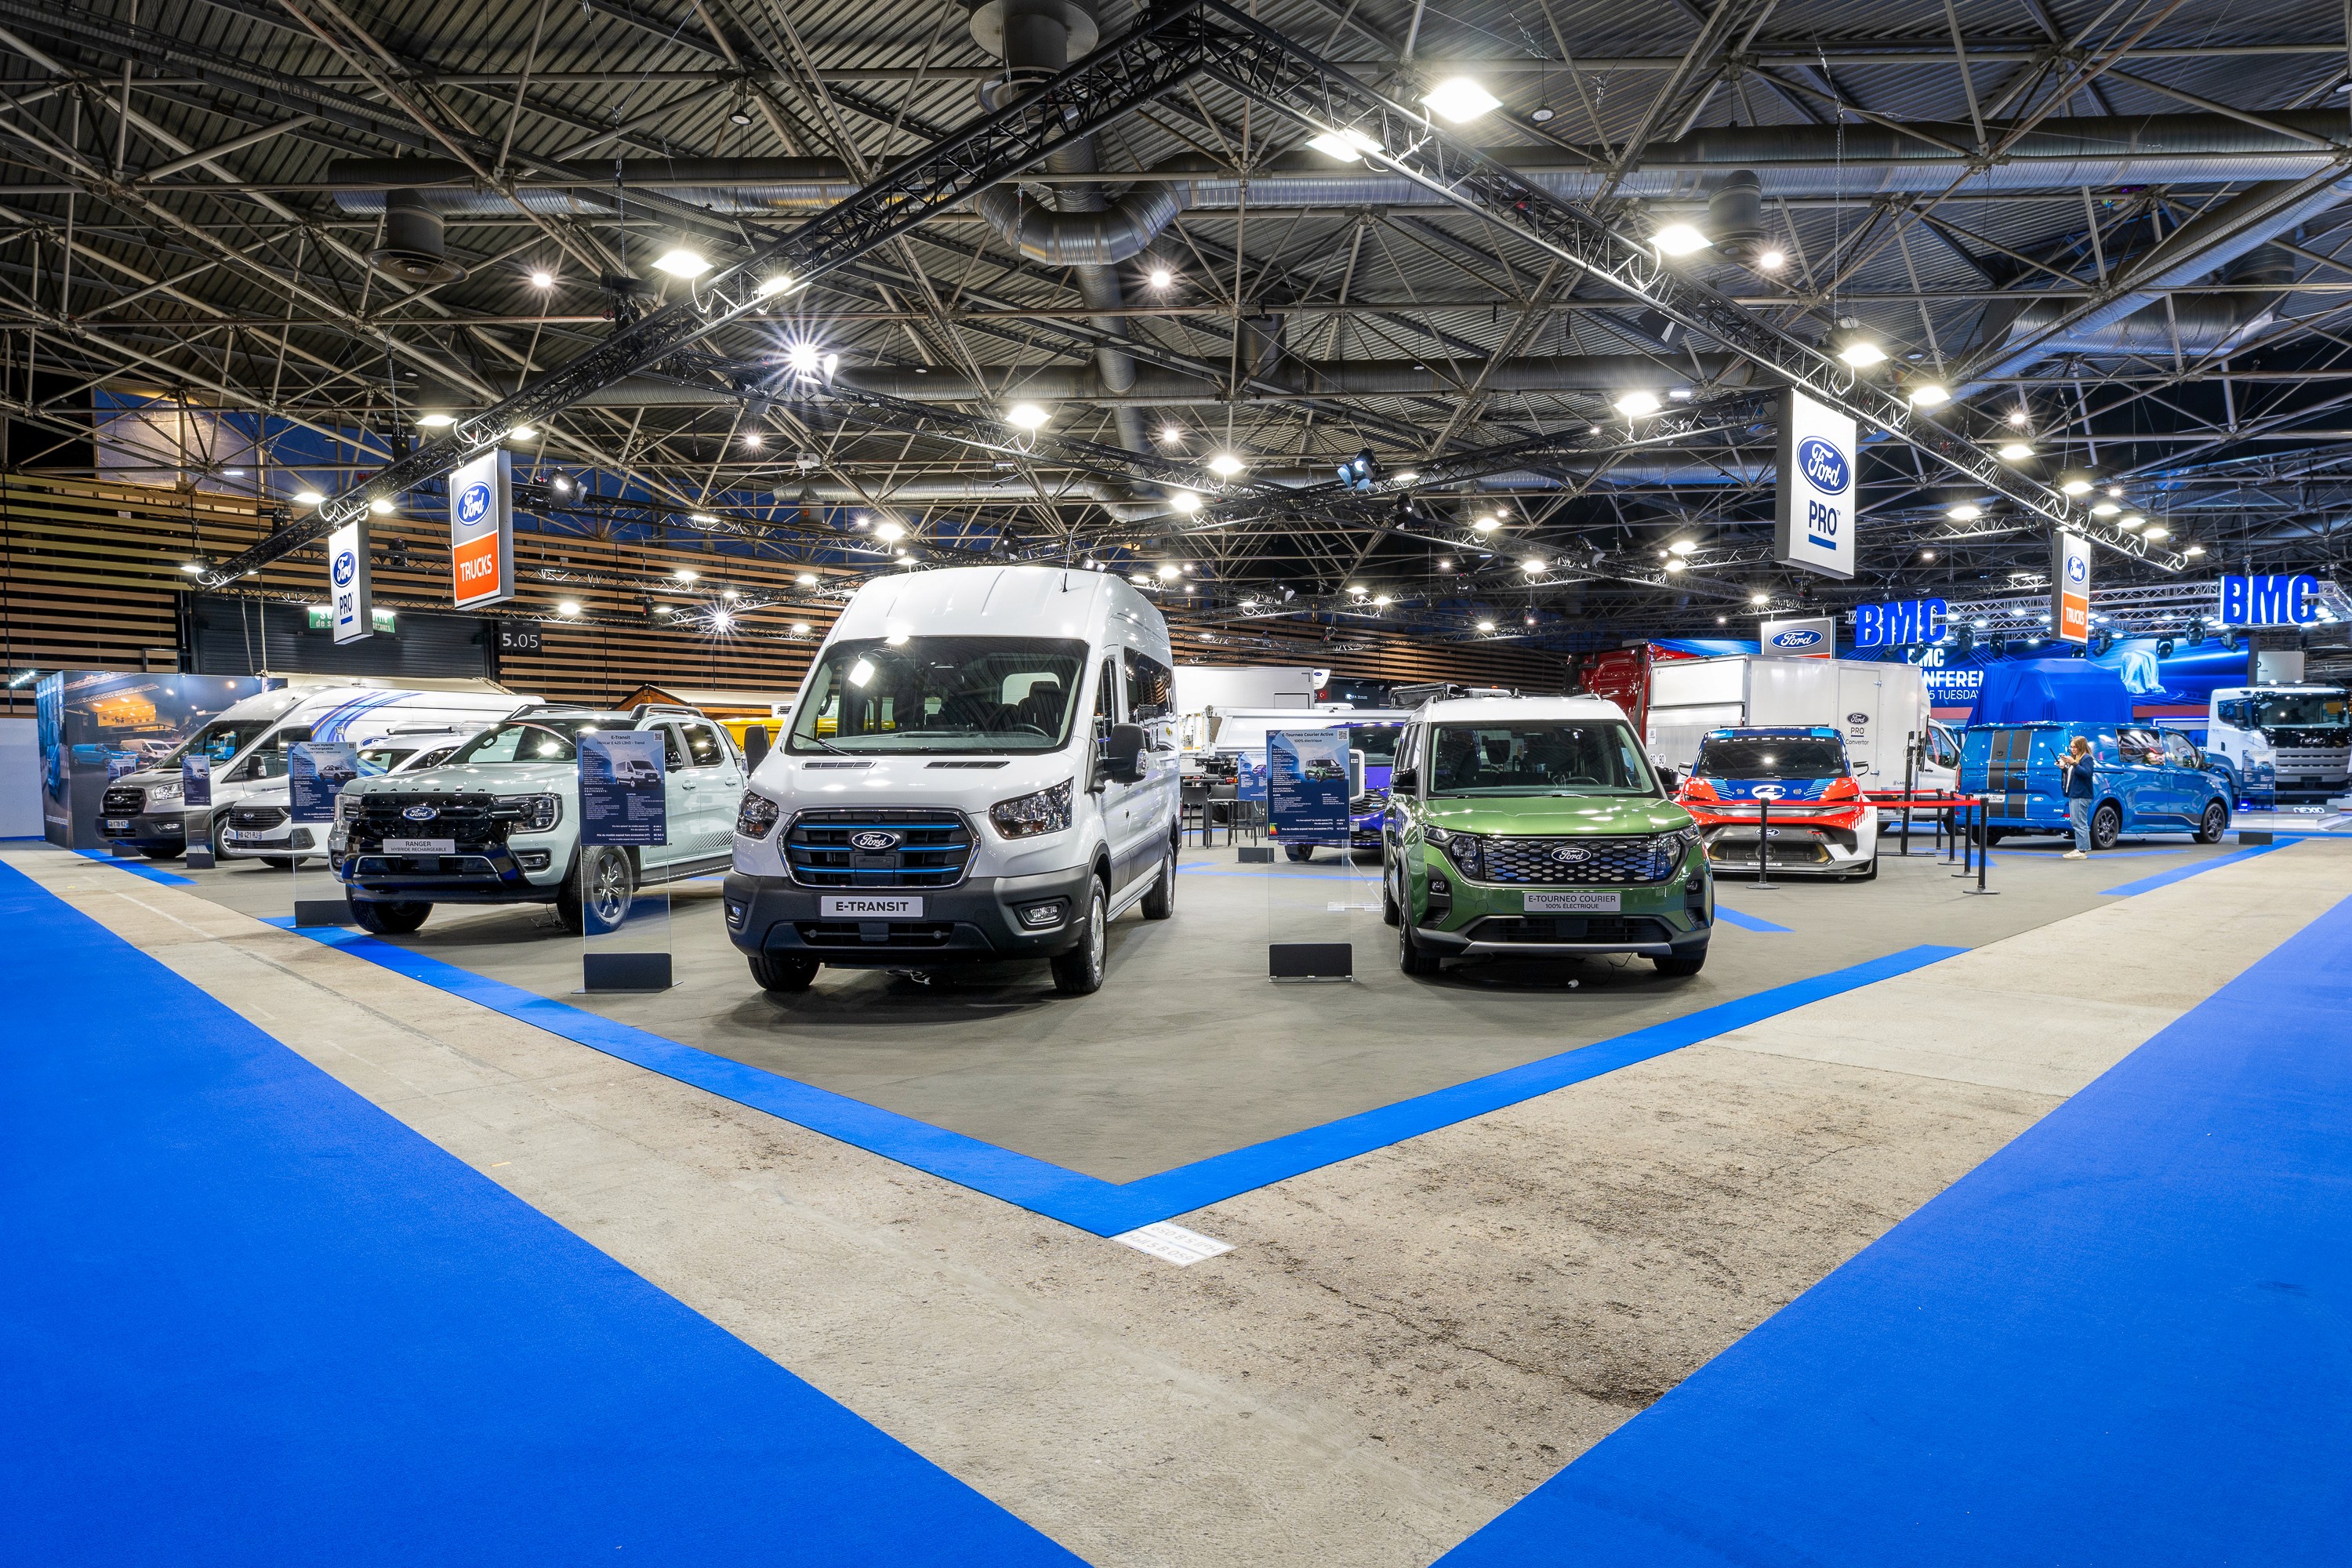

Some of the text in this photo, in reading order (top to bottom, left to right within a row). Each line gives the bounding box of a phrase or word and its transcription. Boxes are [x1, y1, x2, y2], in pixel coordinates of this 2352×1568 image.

[1808, 443, 1841, 488] Ford
[463, 488, 484, 518] Ford
[337, 557, 352, 581] Ford
[459, 554, 492, 582] TRUCKS
[2070, 560, 2084, 583] Ford
[2220, 575, 2318, 626] BMC
[1856, 598, 1949, 648] BMC
[2065, 606, 2085, 626] TRUCKS
[503, 633, 539, 648] 5.05
[1780, 630, 1813, 646] Ford
[1937, 690, 1979, 700] TUESDA
[1850, 714, 1865, 723] Ford
[409, 808, 428, 817] Ford
[859, 833, 887, 848] Ford
[1559, 849, 1584, 860] Ford
[836, 901, 909, 912] E-TRANSIT
[1151, 1226, 1175, 1236] 059
[1123, 1233, 1148, 1245] Hall
[1167, 1250, 1194, 1261] 059
[1195, 1242, 1221, 1252] Hall
